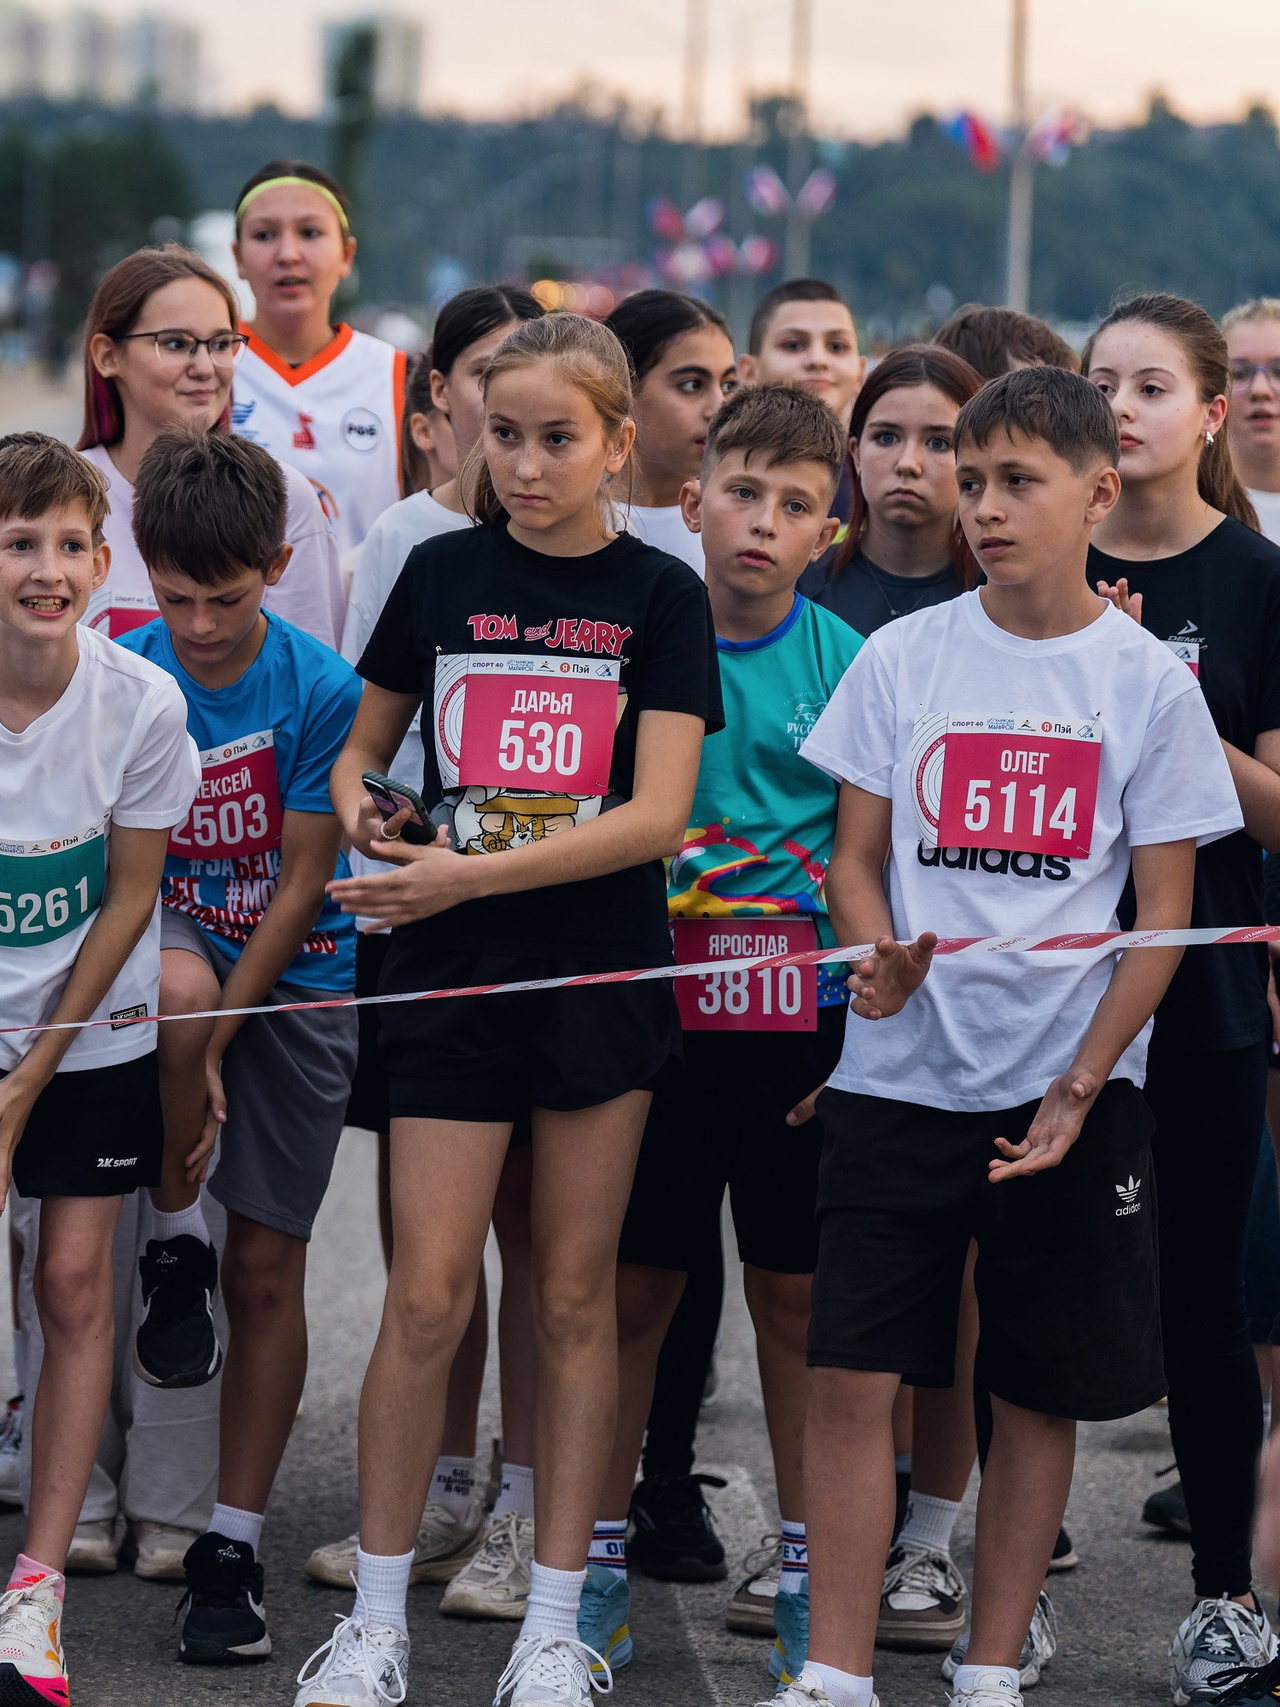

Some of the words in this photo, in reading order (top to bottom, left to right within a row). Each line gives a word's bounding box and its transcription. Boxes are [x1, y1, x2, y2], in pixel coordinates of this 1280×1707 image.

[467, 614, 518, 640] TOM
[524, 620, 553, 642] and
[544, 618, 633, 656] JERRY
[573, 664, 589, 673] Пэй
[510, 690, 572, 714] ДАРЬЯ
[1054, 724, 1071, 734] Пэй
[233, 743, 248, 754] Пэй
[498, 719, 582, 776] 530
[1000, 750, 1050, 775] ОЛЕГ
[171, 793, 268, 846] 2503
[964, 780, 1077, 840] 5114
[63, 836, 78, 846] Пэй
[708, 934, 788, 956] ЯРОСЛАВ
[698, 965, 801, 1015] 3810
[97, 1158, 114, 1167] 2K
[113, 1157, 138, 1167] SPORT
[1116, 1202, 1141, 1216] adidas
